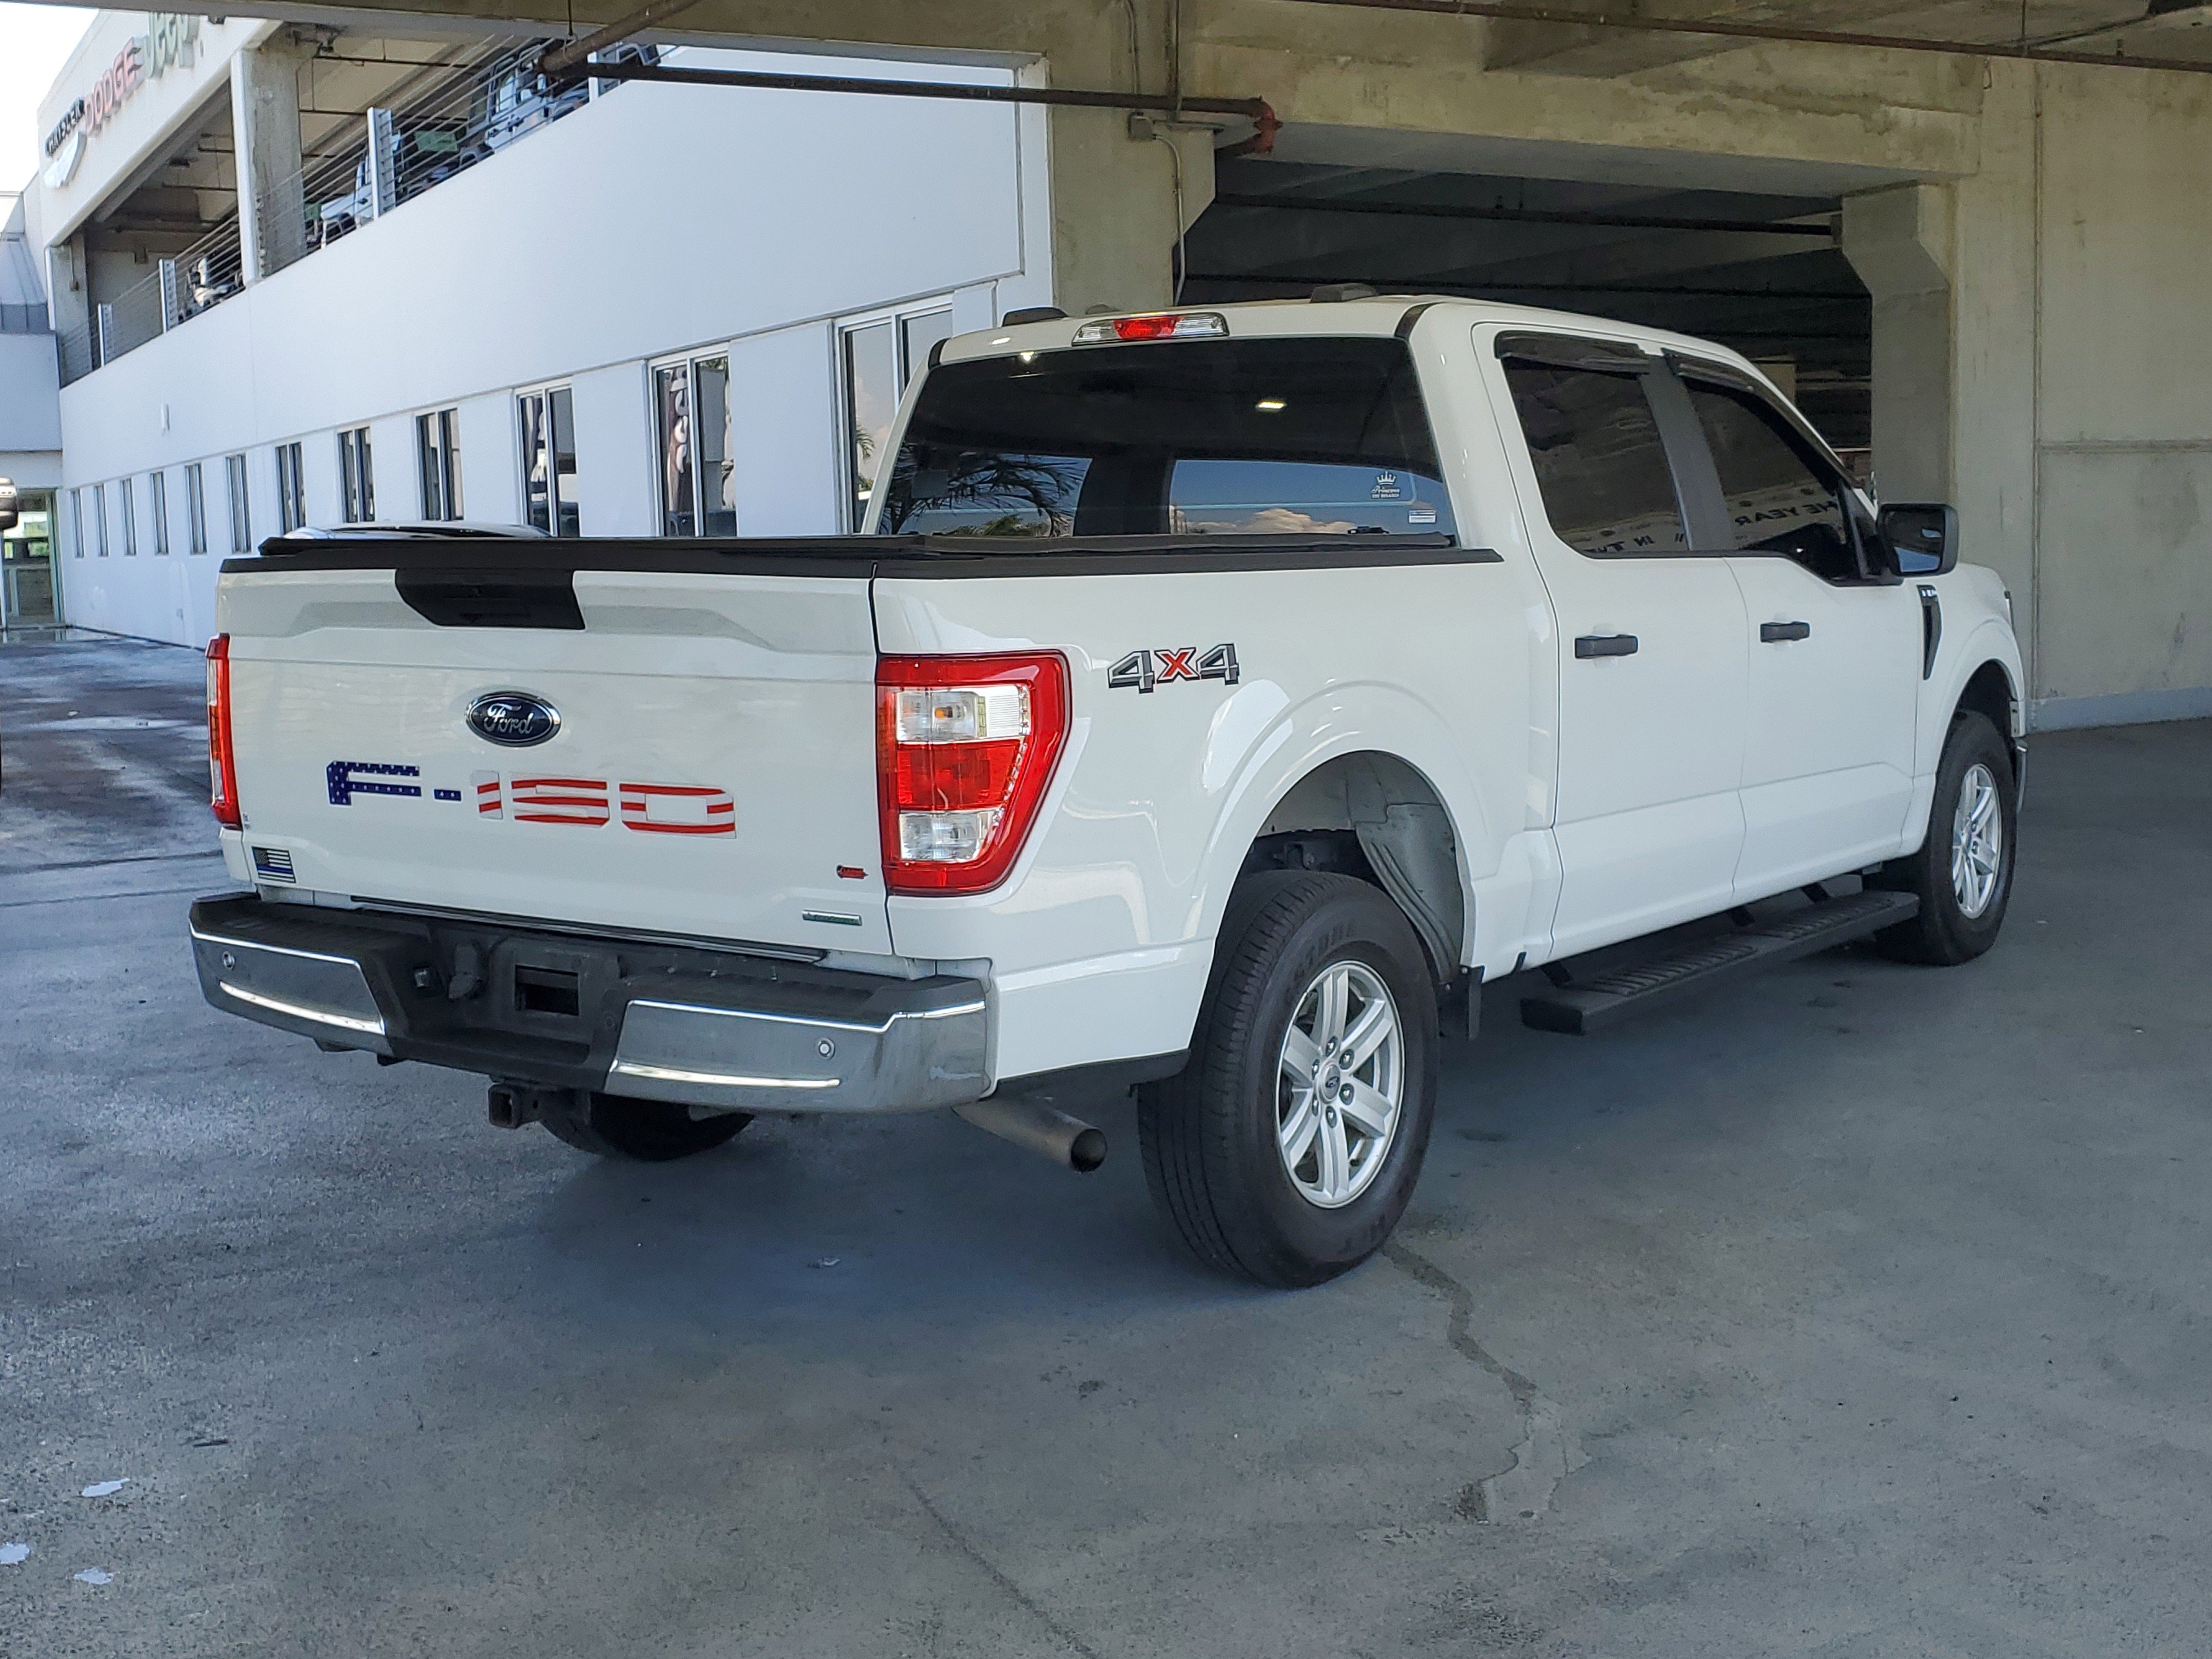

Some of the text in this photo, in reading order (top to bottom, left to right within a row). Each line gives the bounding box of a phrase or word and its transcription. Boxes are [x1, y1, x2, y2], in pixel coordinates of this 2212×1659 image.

[84, 36, 140, 136] DODGE
[483, 703, 533, 735] Ford
[326, 760, 736, 839] F-150
